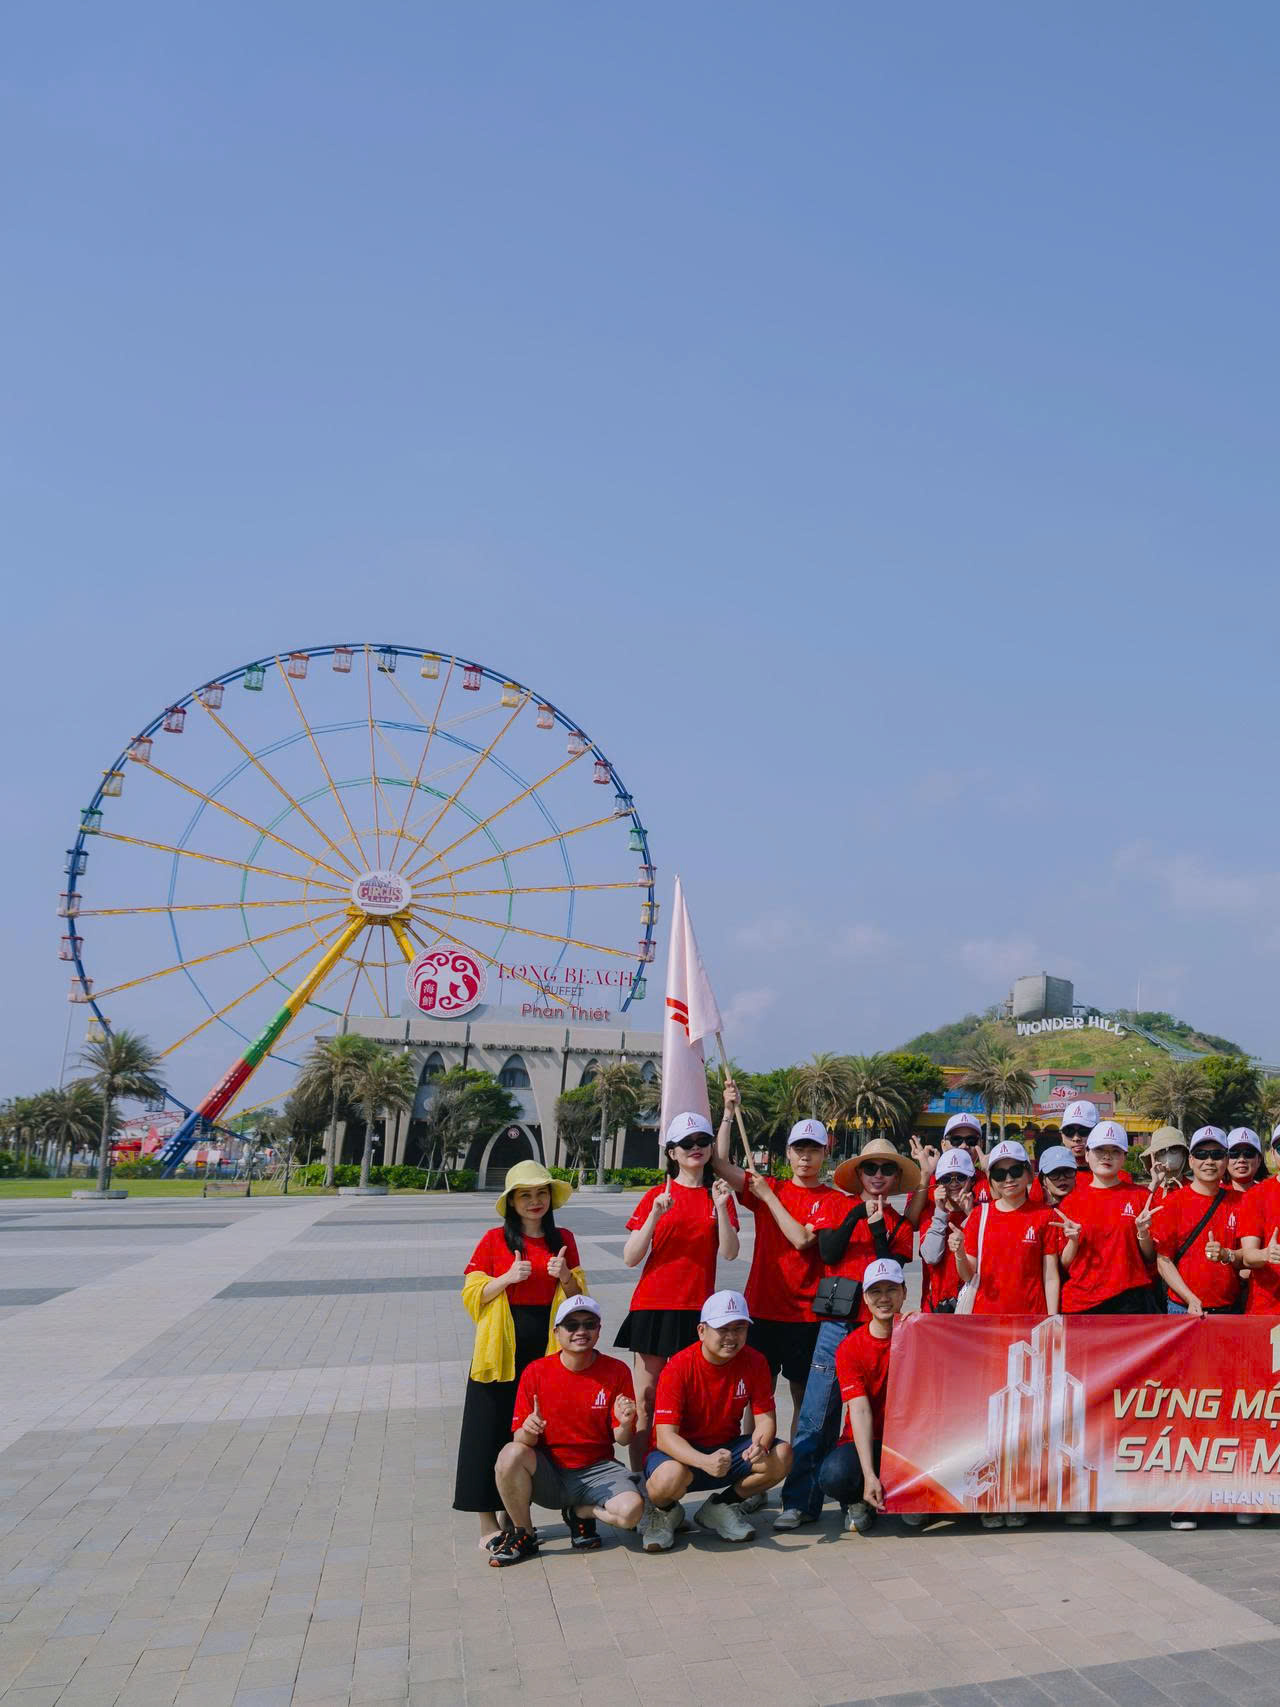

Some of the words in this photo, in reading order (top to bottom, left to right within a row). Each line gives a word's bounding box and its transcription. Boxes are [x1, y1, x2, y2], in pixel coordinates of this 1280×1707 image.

[357, 885, 403, 902] CIRCUS
[498, 963, 557, 982] LONG
[564, 967, 633, 987] BEACH
[544, 985, 585, 997] BUFFET
[521, 1003, 564, 1018] Phan
[1017, 1017, 1085, 1036] WONDER
[1088, 1015, 1127, 1036] HILL
[1113, 1379, 1223, 1419] VỮNG
[1114, 1425, 1240, 1473] SÁNG
[1211, 1488, 1264, 1504] PHAN
